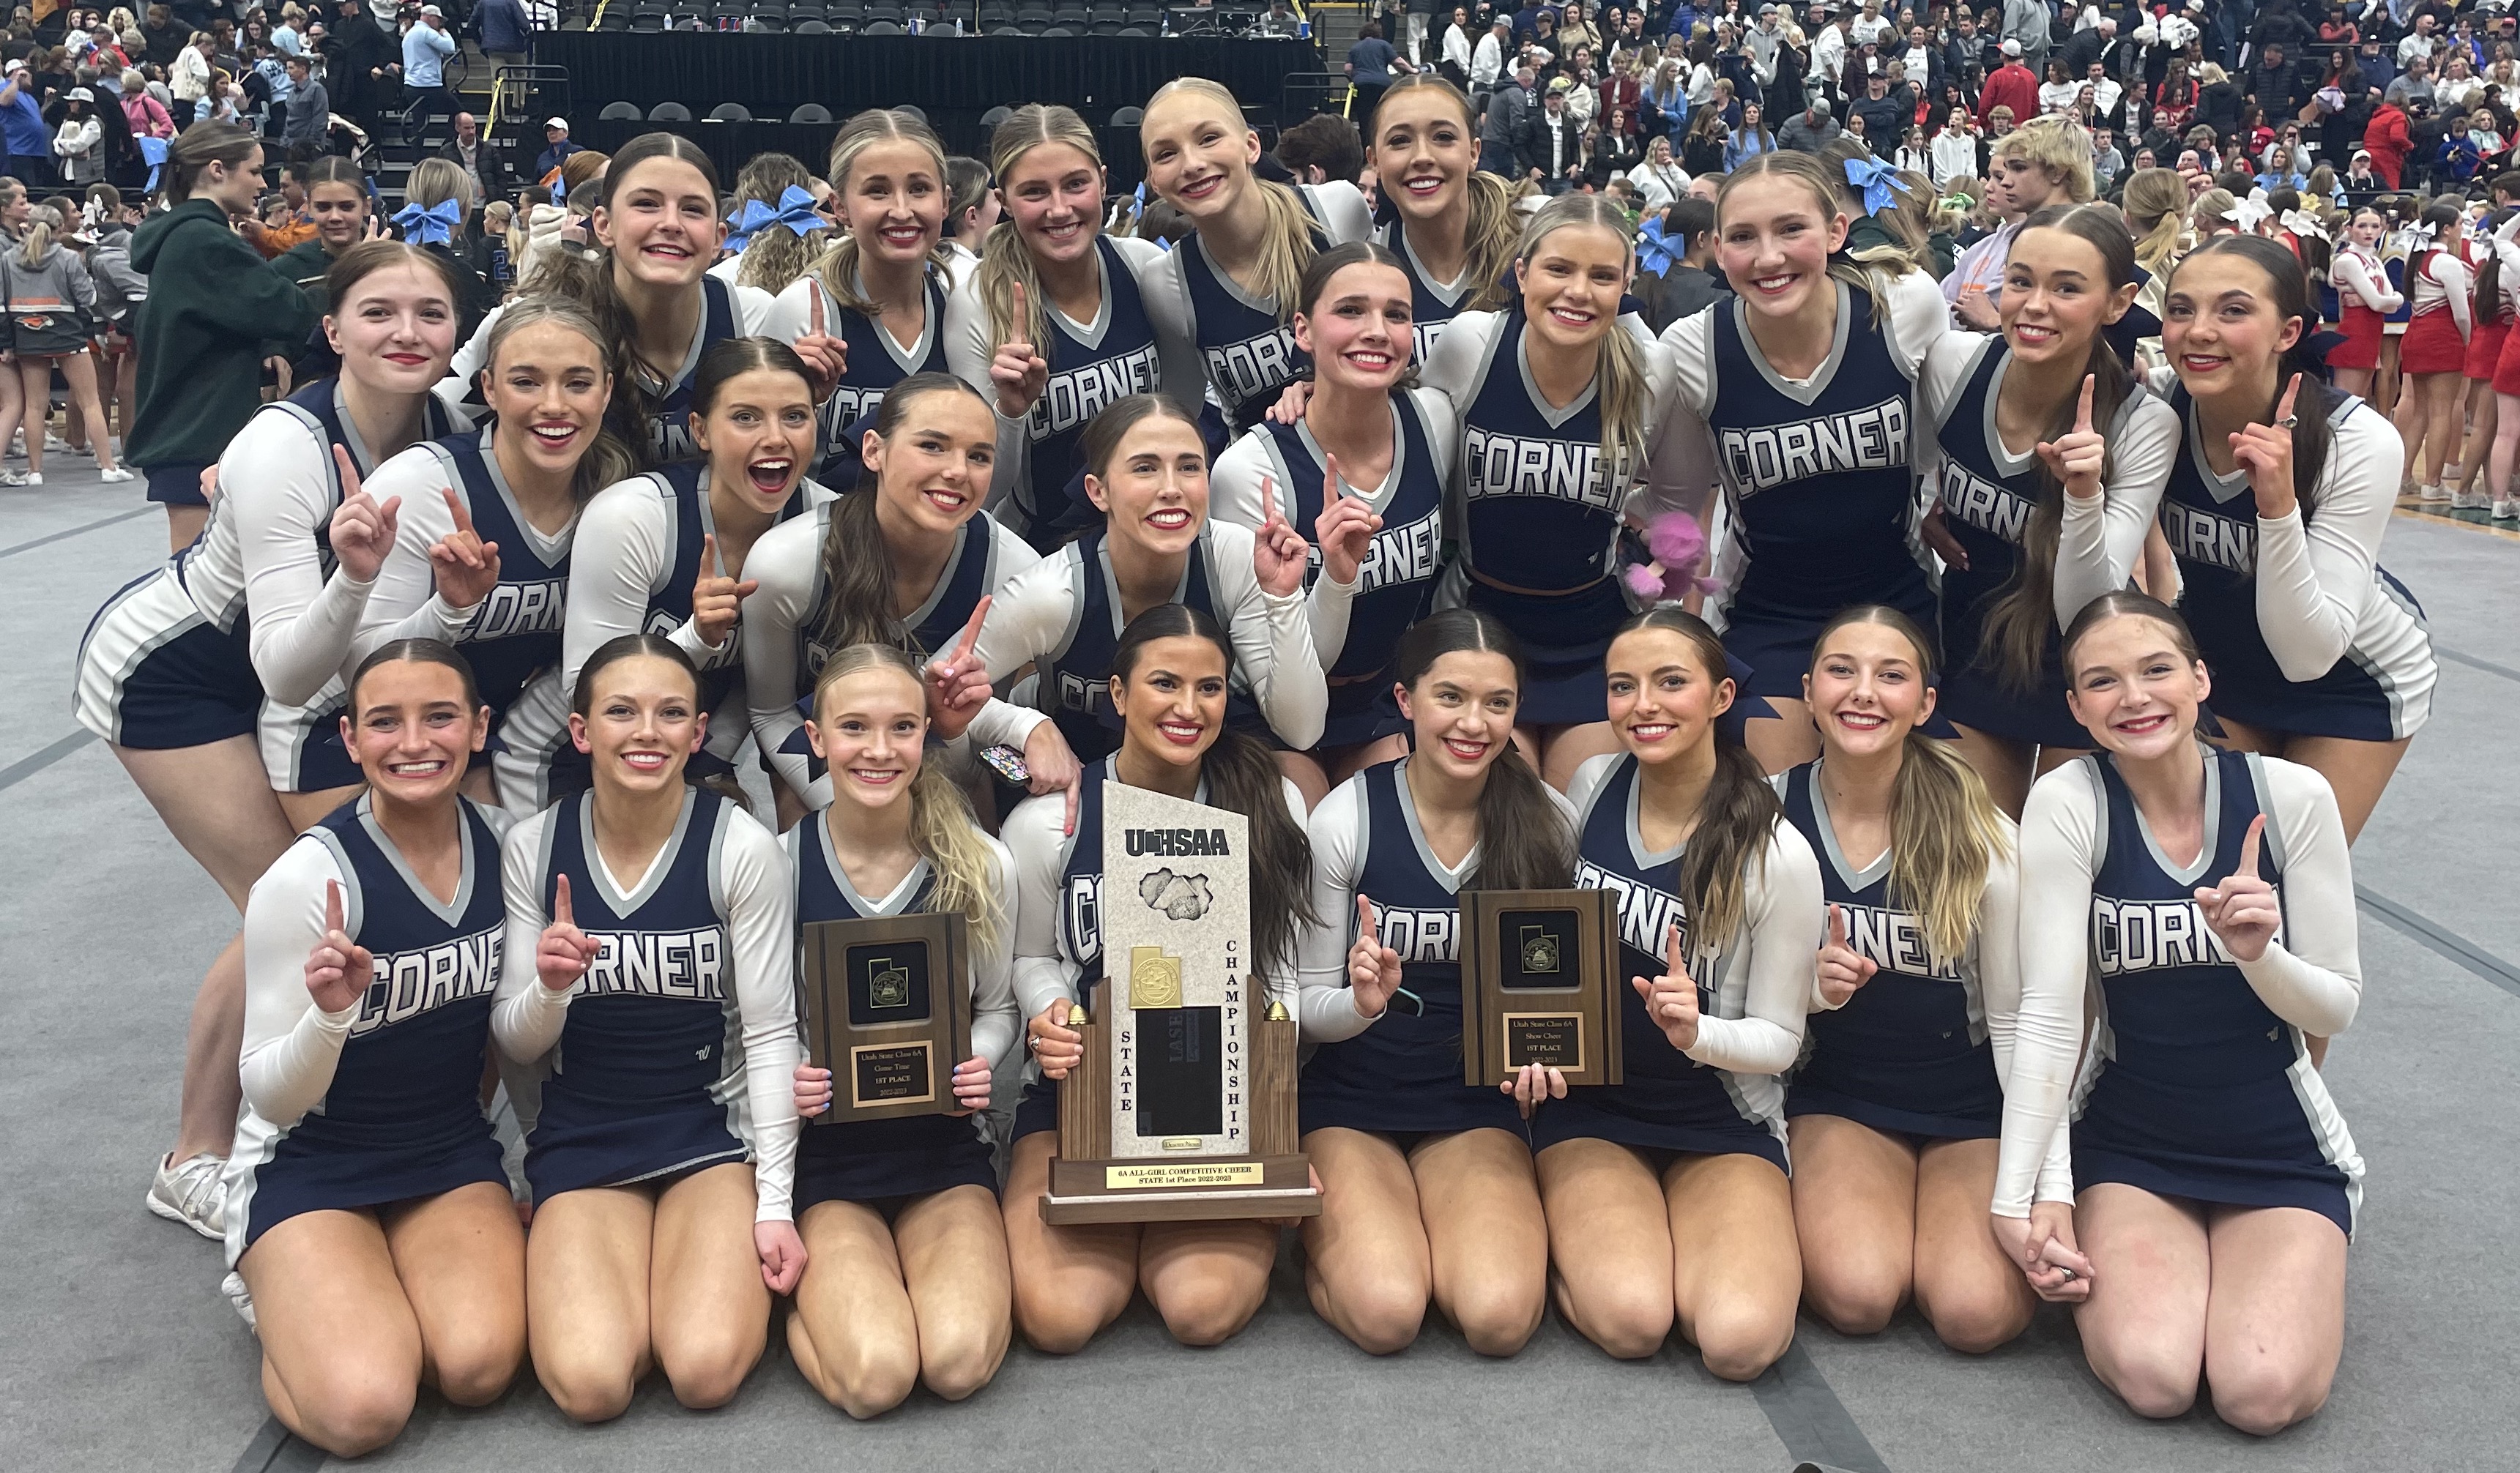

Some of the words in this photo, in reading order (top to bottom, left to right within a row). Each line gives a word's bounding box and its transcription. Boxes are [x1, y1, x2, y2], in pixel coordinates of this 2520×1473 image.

[1465, 428, 1630, 510] CORNER
[1722, 400, 1907, 498] CORNER
[1125, 829, 1230, 857] UHSAA
[888, 1075, 911, 1083] PLACE
[1120, 1031, 1132, 1111] STATE
[1225, 940, 1240, 1141] CHAMPIONSHIP
[1169, 1167, 1223, 1176] COMPETITIVE
